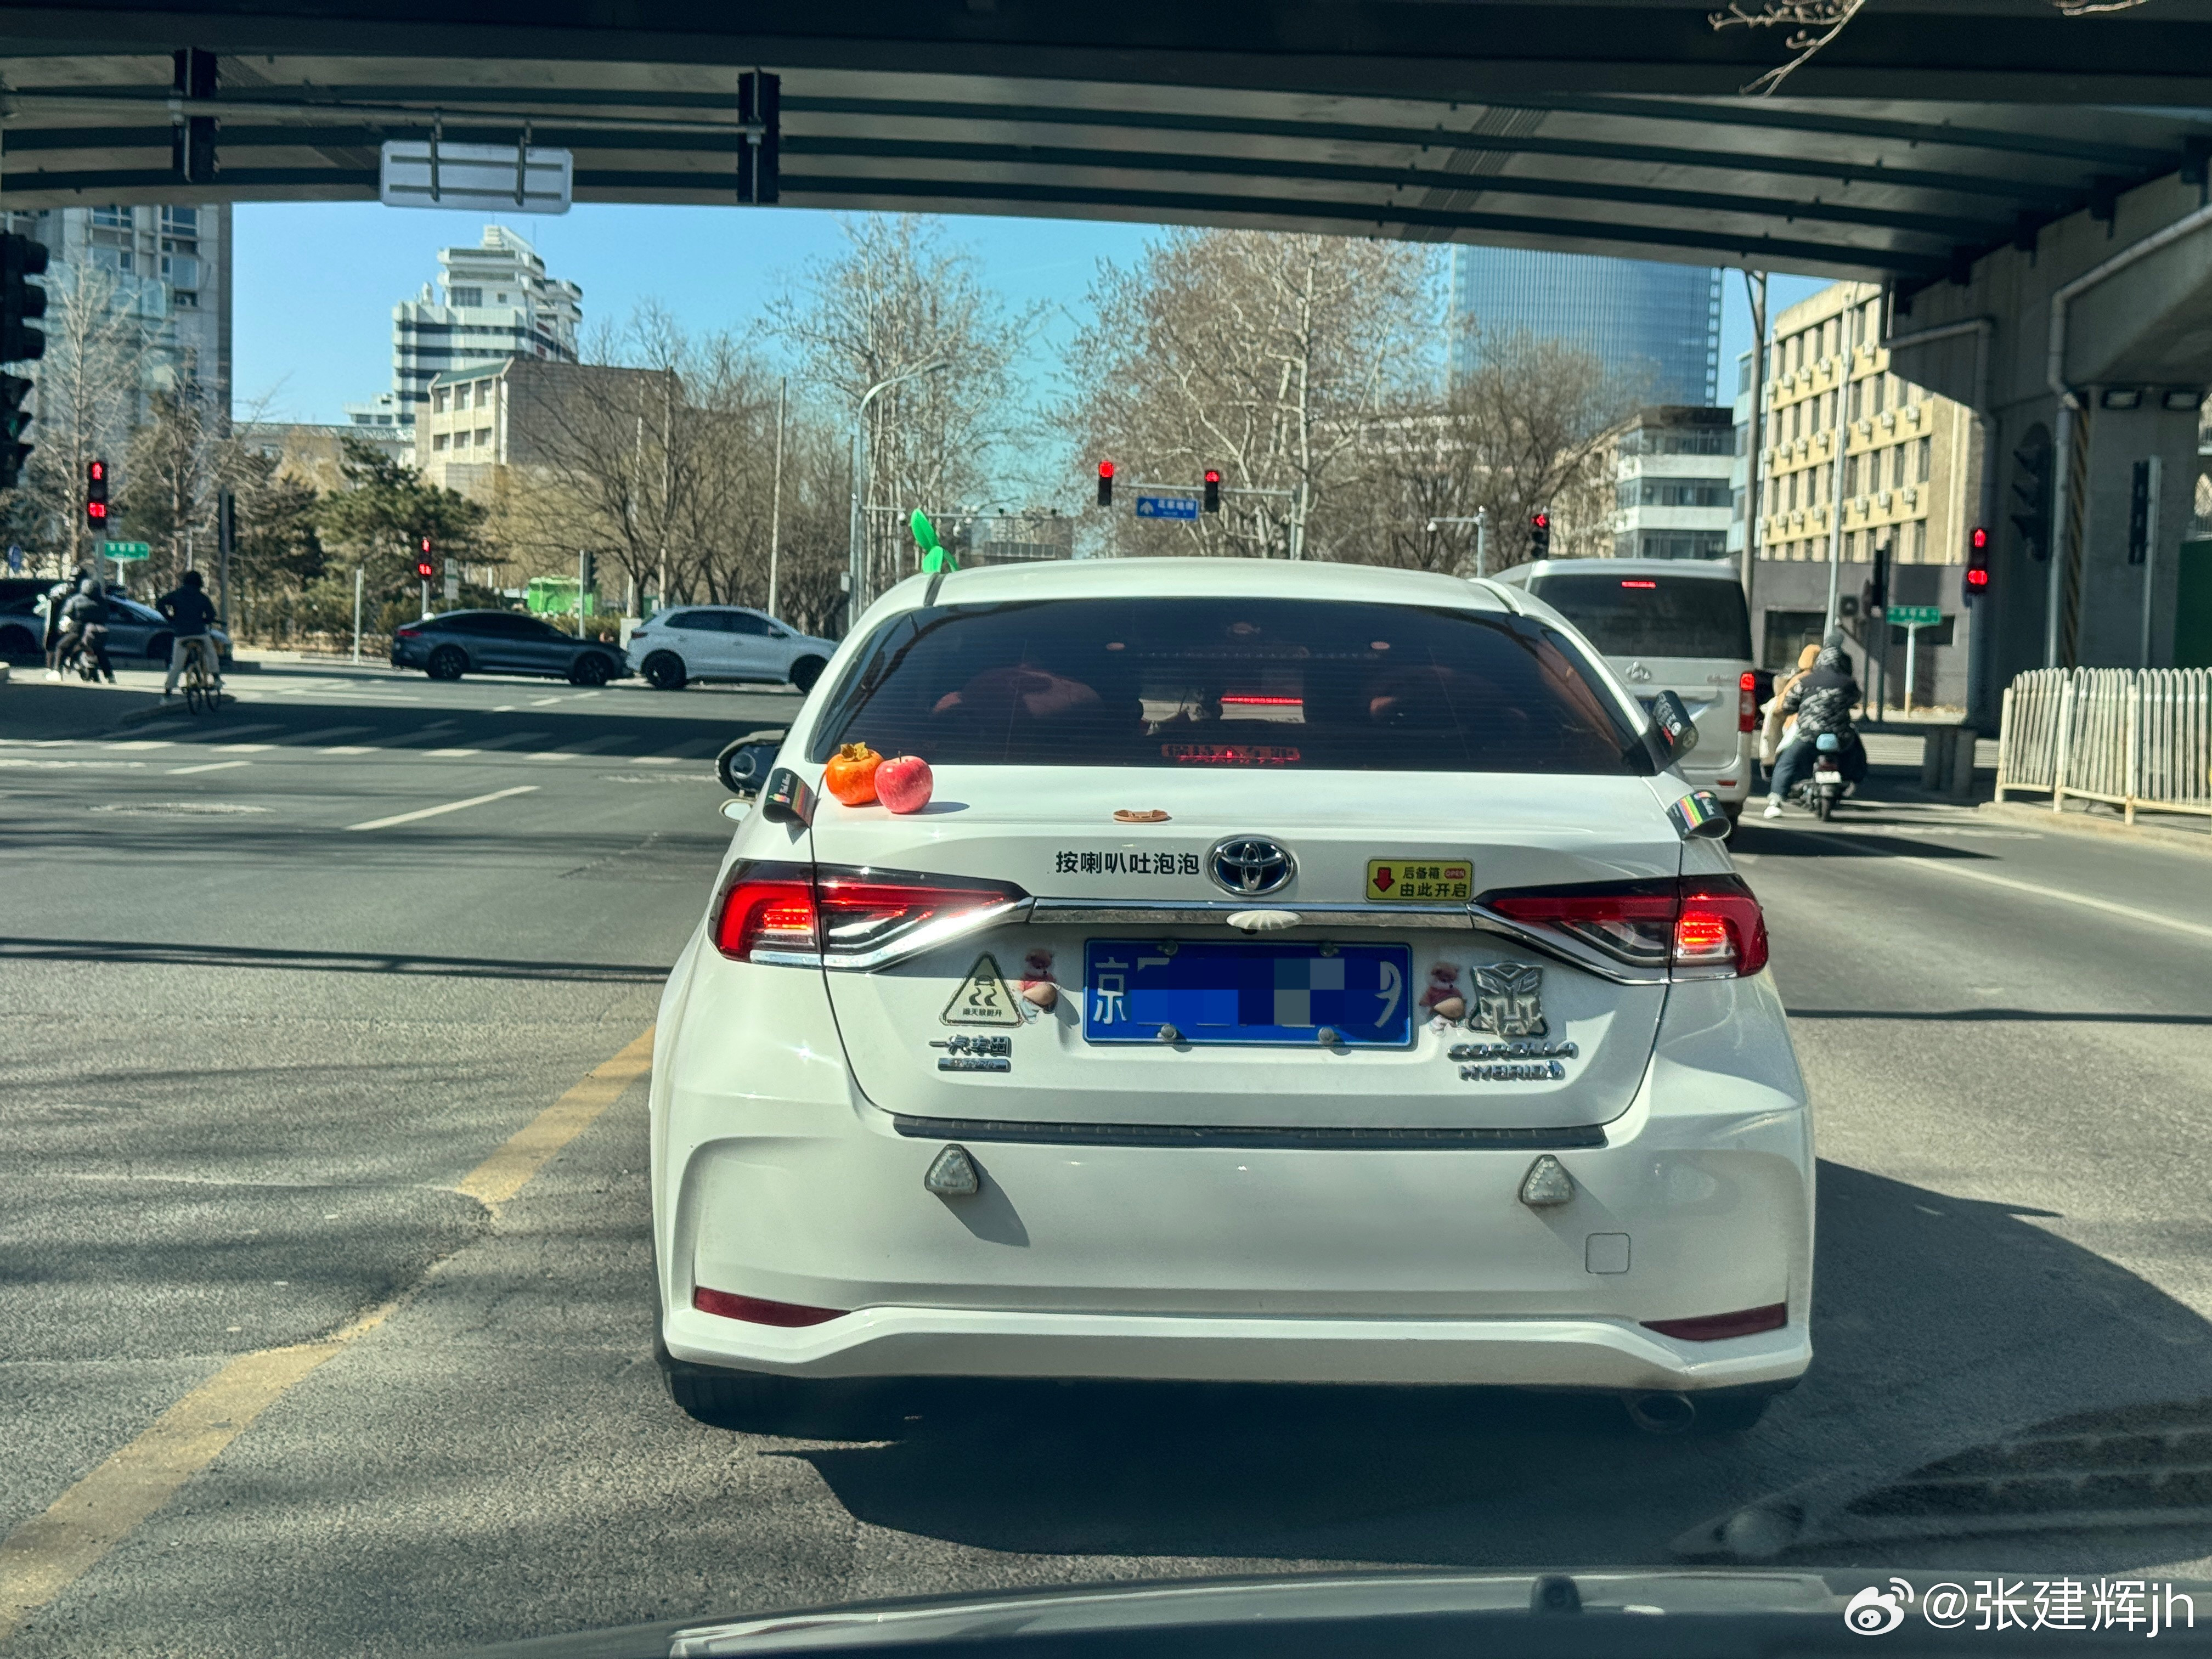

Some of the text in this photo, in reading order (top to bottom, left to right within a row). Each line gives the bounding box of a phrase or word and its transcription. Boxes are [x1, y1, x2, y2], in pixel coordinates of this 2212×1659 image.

[1056, 851, 1200, 875] 按喇叭吐泡泡
[1403, 866, 1441, 879] 后备箱
[1400, 882, 1467, 898] 由此开启
[1447, 1043, 1578, 1062] COROLLA
[1458, 1064, 1547, 1081] HYBRID
